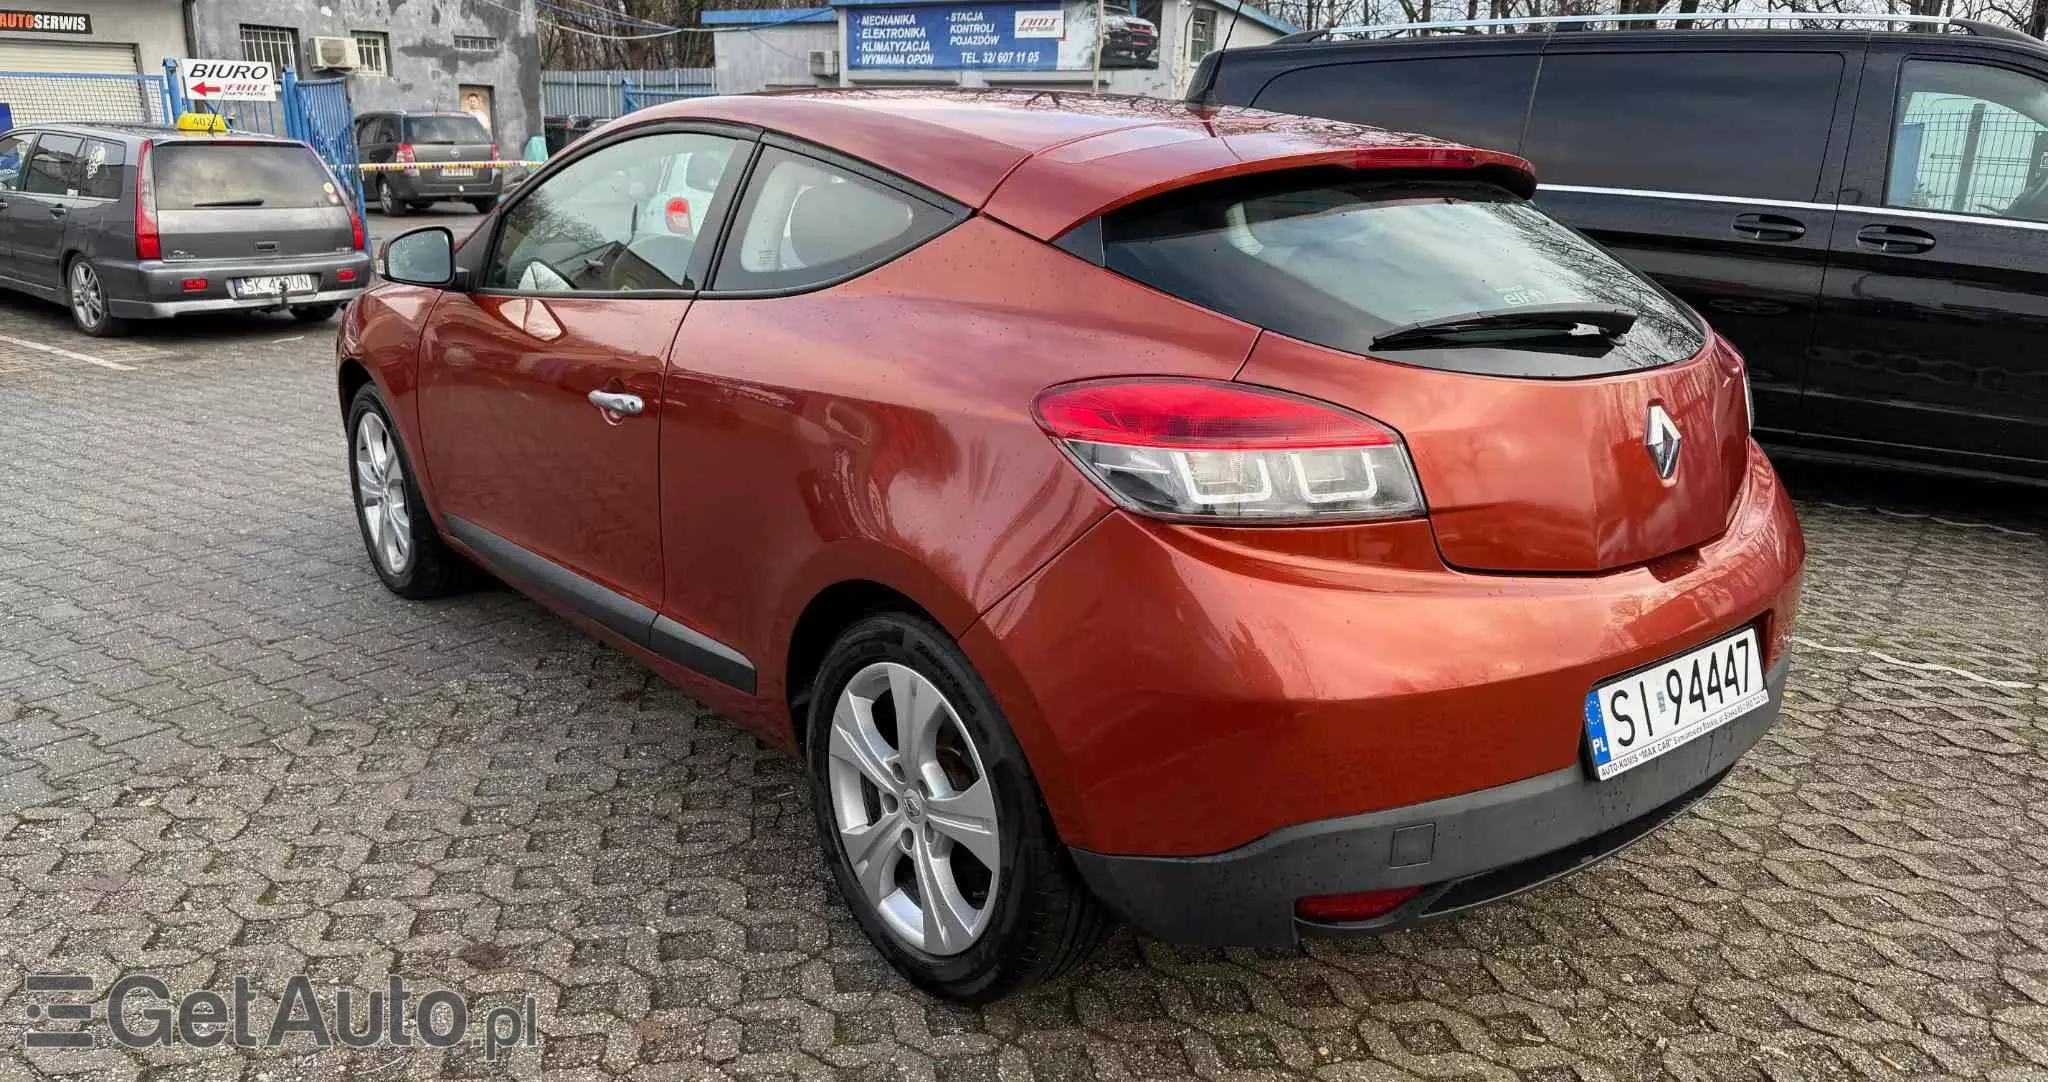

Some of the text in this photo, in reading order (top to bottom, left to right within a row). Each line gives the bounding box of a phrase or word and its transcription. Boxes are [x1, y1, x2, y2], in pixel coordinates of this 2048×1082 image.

[0, 12, 86, 31] AUTOSERWIS
[861, 14, 916, 26] MECHANIKA
[950, 11, 984, 22] STACJA
[861, 27, 927, 39] ELEKTRONIKA
[950, 23, 995, 34] KONTROLI
[861, 40, 930, 52] KLIMATYZACJA
[950, 34, 1001, 46] POJAZDÓW
[861, 53, 935, 65] WYMIANA OPON
[997, 51, 1014, 63] 607
[1015, 51, 1026, 63] 11
[1027, 51, 1041, 63] 05
[189, 63, 268, 80] BIURO
[1610, 681, 1654, 747] SI
[1666, 637, 1750, 726] 94447
[1593, 736, 1608, 756] PL
